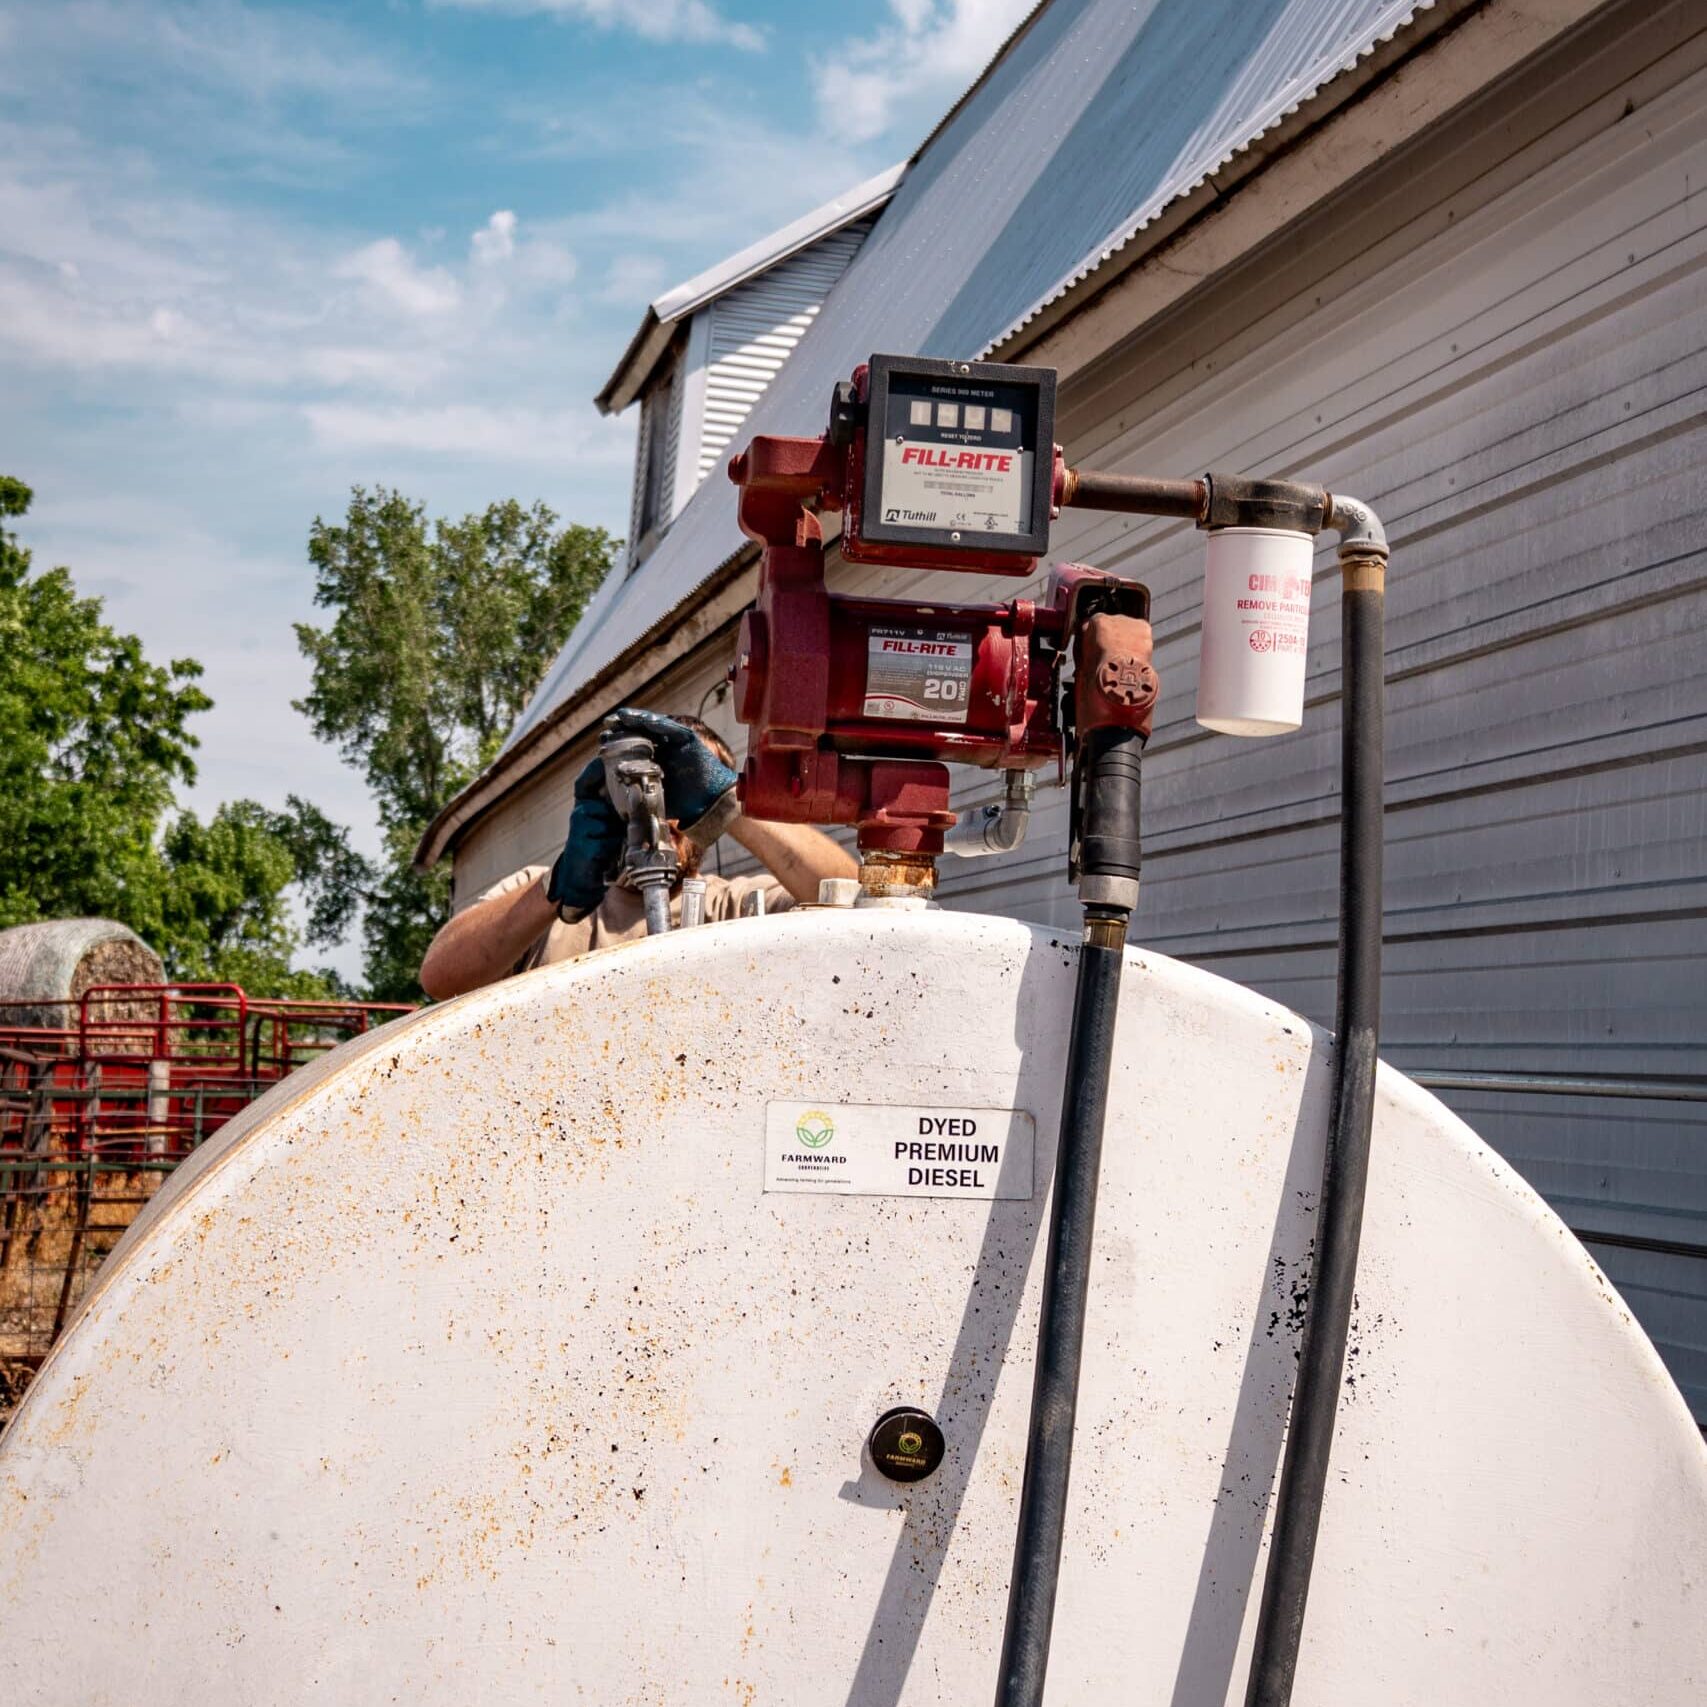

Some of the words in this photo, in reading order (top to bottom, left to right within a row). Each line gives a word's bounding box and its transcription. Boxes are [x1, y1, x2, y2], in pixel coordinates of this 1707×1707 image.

[901, 447, 1013, 473] FILL-RITE
[902, 509, 937, 522] Tuthill
[1236, 599, 1278, 612] REMOVE
[882, 640, 957, 656] FILL-RITE
[923, 678, 958, 700] 20
[918, 1116, 977, 1137] DYED
[781, 1153, 847, 1165] FARMWARD
[894, 1141, 999, 1164] PREMIUM
[908, 1167, 985, 1188] DIESEL
